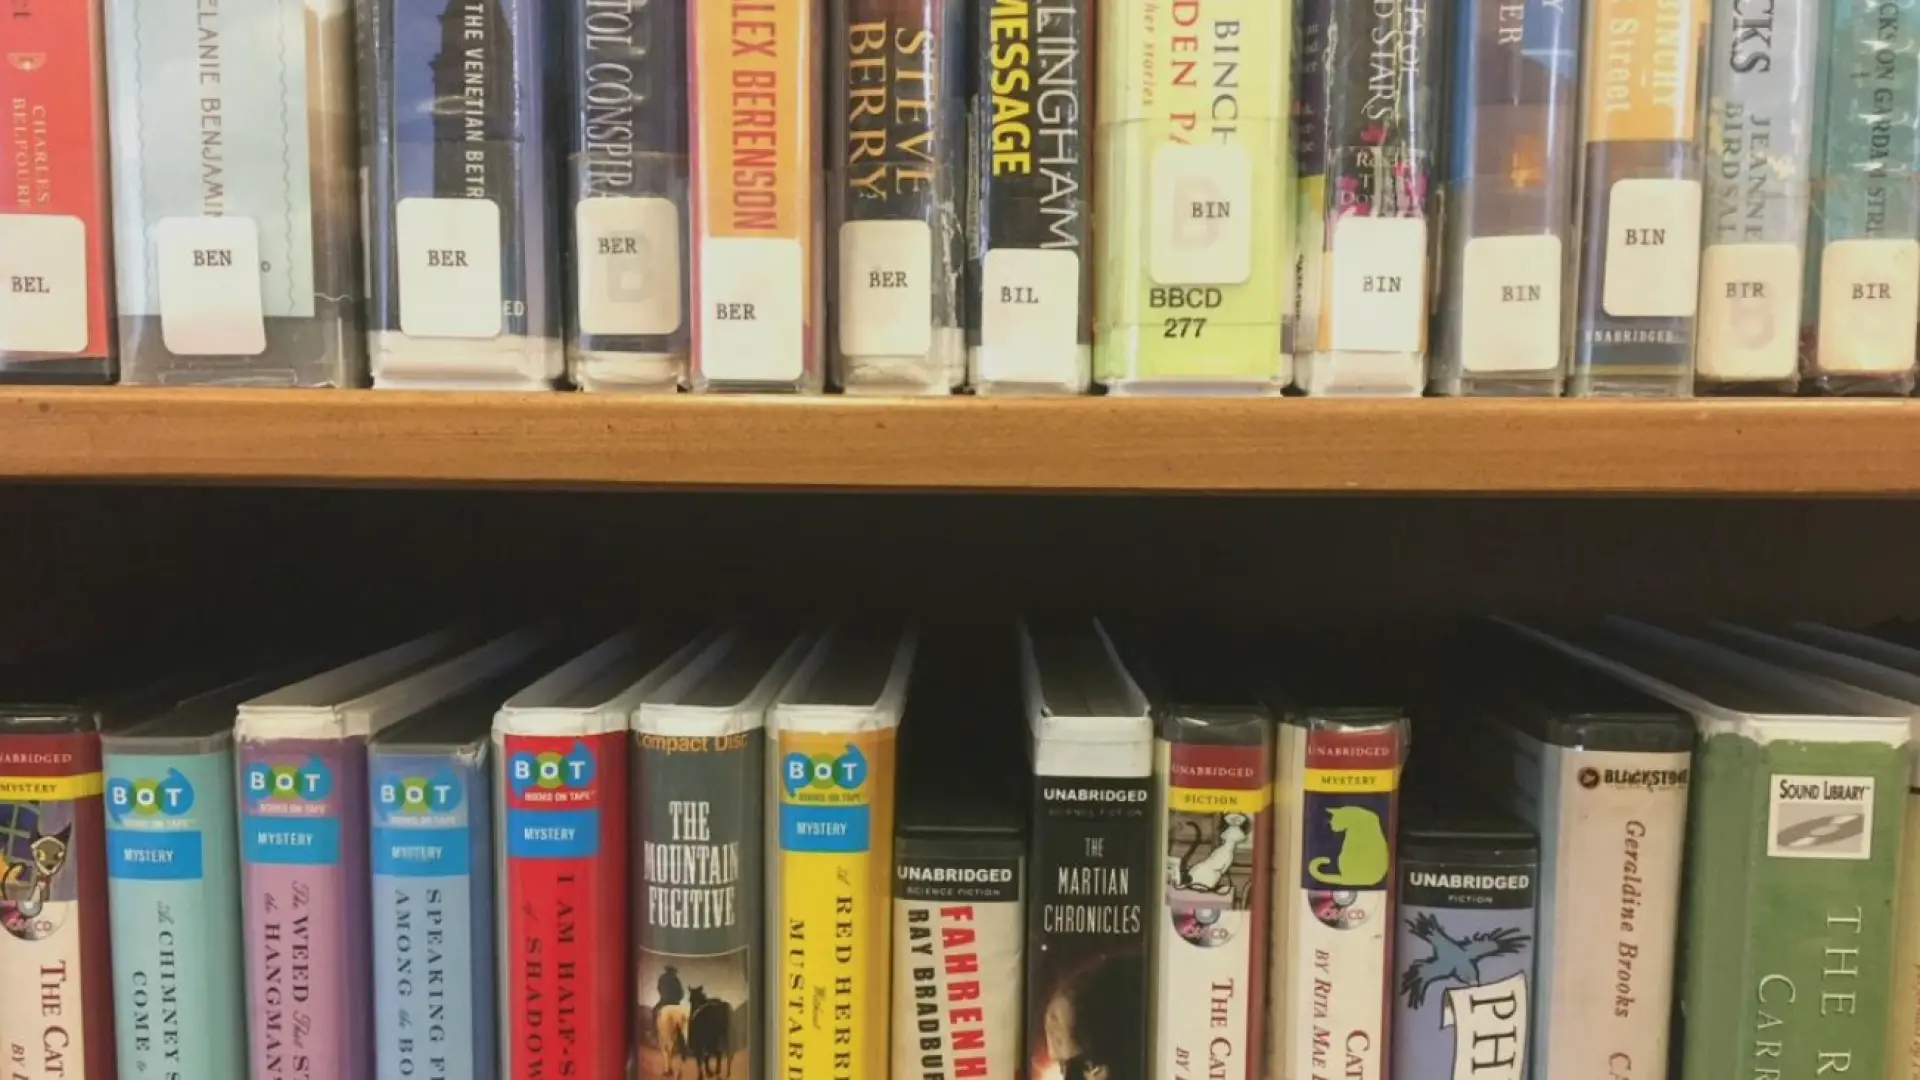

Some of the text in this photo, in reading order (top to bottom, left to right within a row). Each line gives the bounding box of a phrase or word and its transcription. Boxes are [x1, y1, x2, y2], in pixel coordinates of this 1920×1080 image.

[464, 3, 485, 41] THE
[1360, 28, 1402, 120] STARS
[1873, 49, 1897, 81] ON
[464, 48, 486, 142] VENETIAN
[848, 20, 889, 200] BERRY
[893, 27, 935, 195] STEVE
[32, 105, 51, 204] CHARLES
[731, 70, 777, 231] BERENSON
[1191, 202, 1231, 219] BIN
[598, 237, 638, 255] BER
[1625, 229, 1666, 246] BIN
[193, 249, 233, 267] BEN
[427, 249, 469, 267] BER
[11, 276, 50, 294] BEL
[868, 271, 909, 289] BER
[1363, 276, 1402, 293] BIN
[1000, 286, 1040, 304] BIL
[1149, 288, 1223, 308] BBCD
[1501, 285, 1541, 302] BIN
[1852, 283, 1893, 301] BIR
[716, 303, 757, 321] BER
[1164, 318, 1207, 339] 277
[1307, 744, 1391, 757] UNABRIDGED
[515, 760, 586, 780] BOT
[788, 761, 858, 781] BOT
[1171, 765, 1254, 778] UNABRIDGED
[1320, 775, 1379, 787] MYSTERY
[251, 771, 321, 793] BOT
[1779, 778, 1820, 801] SOUND
[112, 786, 184, 808] BOT
[381, 784, 452, 805] BOT
[1043, 788, 1148, 803] UNABRIDGED
[1184, 793, 1238, 806] FICTION
[668, 800, 711, 841] THE
[796, 821, 848, 836] MYSTERY
[257, 831, 314, 846] MYSTERY
[524, 826, 576, 841] MYSTERY
[1083, 837, 1105, 858] THE
[643, 840, 739, 885] MOUNTAIN
[897, 865, 1013, 884] UNABRIDGED
[1058, 867, 1129, 896] MARTIAN
[1409, 871, 1530, 890] UNABRIDGED
[1619, 819, 1647, 933] Geraldine
[648, 886, 736, 929] FUGITIVE
[1043, 904, 1141, 934] CHRONICLES
[556, 900, 575, 944] AM
[835, 895, 853, 964] RED
[908, 908, 934, 957] RAY
[395, 889, 413, 998] AMONG
[291, 916, 310, 1003] WEED
[426, 888, 446, 1043] SPEAKING
[1315, 948, 1330, 974] BY
[1613, 941, 1639, 1019] Brooks
[1816, 905, 1862, 1075] THE R
[158, 930, 181, 1065] CHIMNEY
[940, 905, 989, 1080] FAHRENH
[1210, 977, 1234, 1028] THE
[1313, 977, 1332, 1018] RITA
[39, 959, 70, 1079] THE CAT
[132, 970, 151, 1052] COME
[1311, 1024, 1331, 1069] MAE
